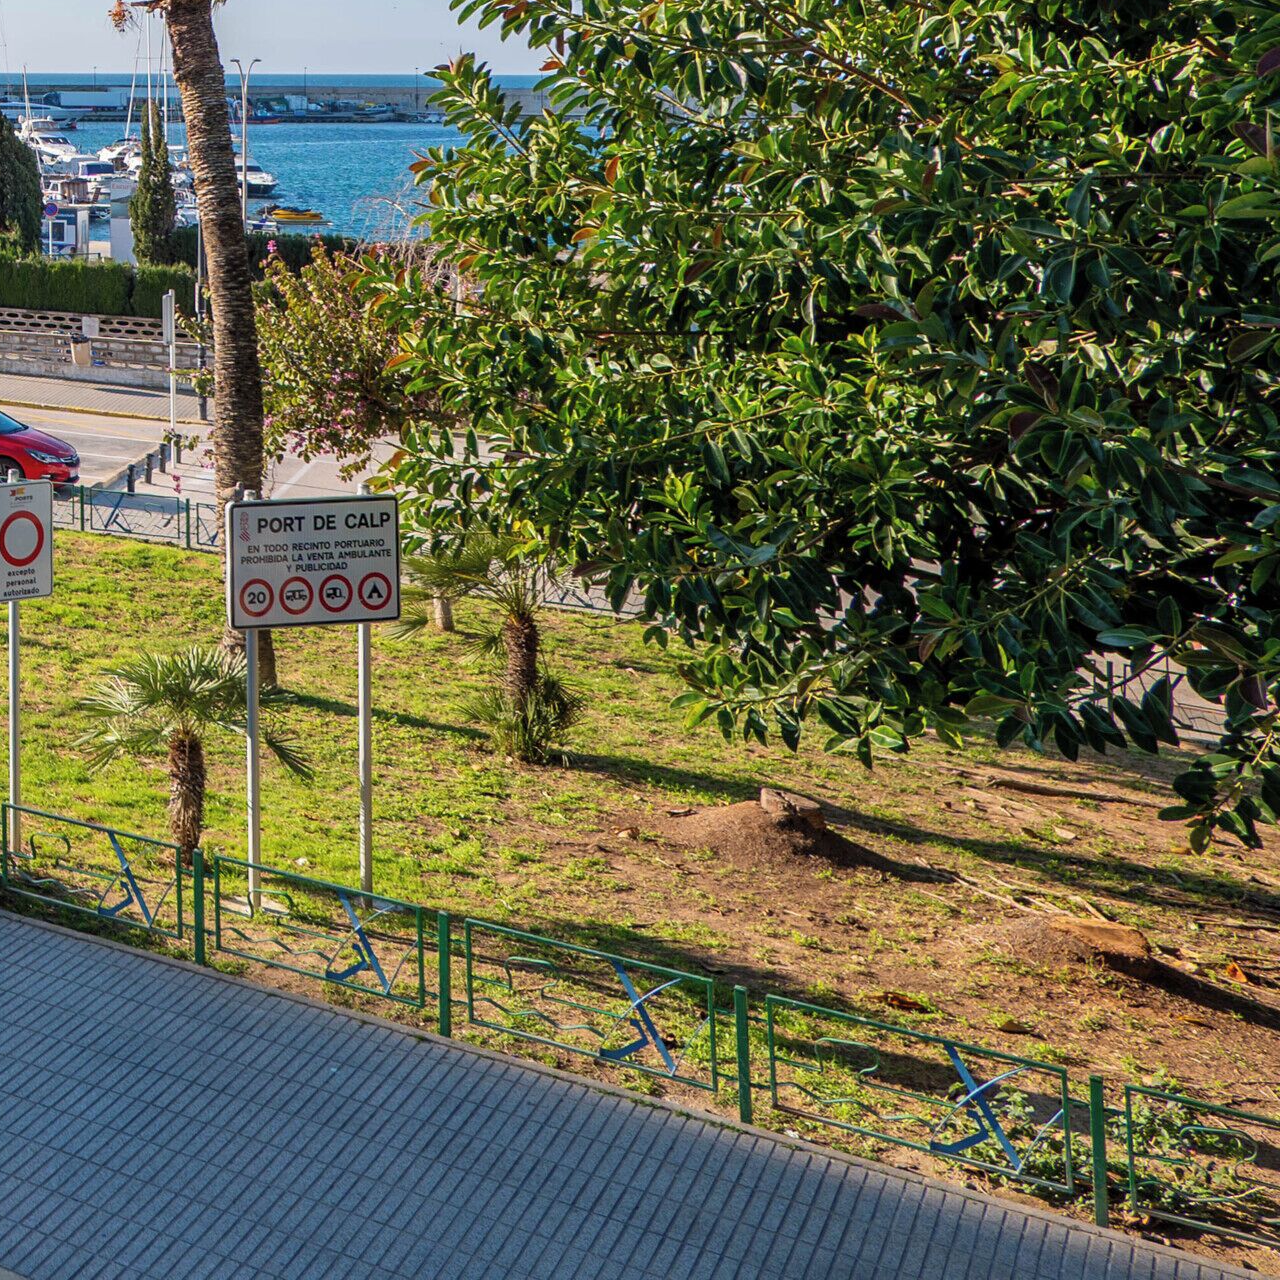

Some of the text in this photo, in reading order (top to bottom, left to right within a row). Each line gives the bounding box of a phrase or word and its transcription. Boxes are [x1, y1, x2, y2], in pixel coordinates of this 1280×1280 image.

[257, 512, 391, 533] PORT DE CALP
[248, 539, 385, 553] EN TODO RECINTO PORTUARIO
[241, 549, 392, 565] PROHIBIDA LA VENTA AMBULANTE
[7, 568, 35, 576] excepto
[286, 562, 348, 573] Y PUBLICIDAD
[6, 577, 37, 588] personal
[3, 587, 40, 597] autorizado
[247, 591, 267, 605] 20
